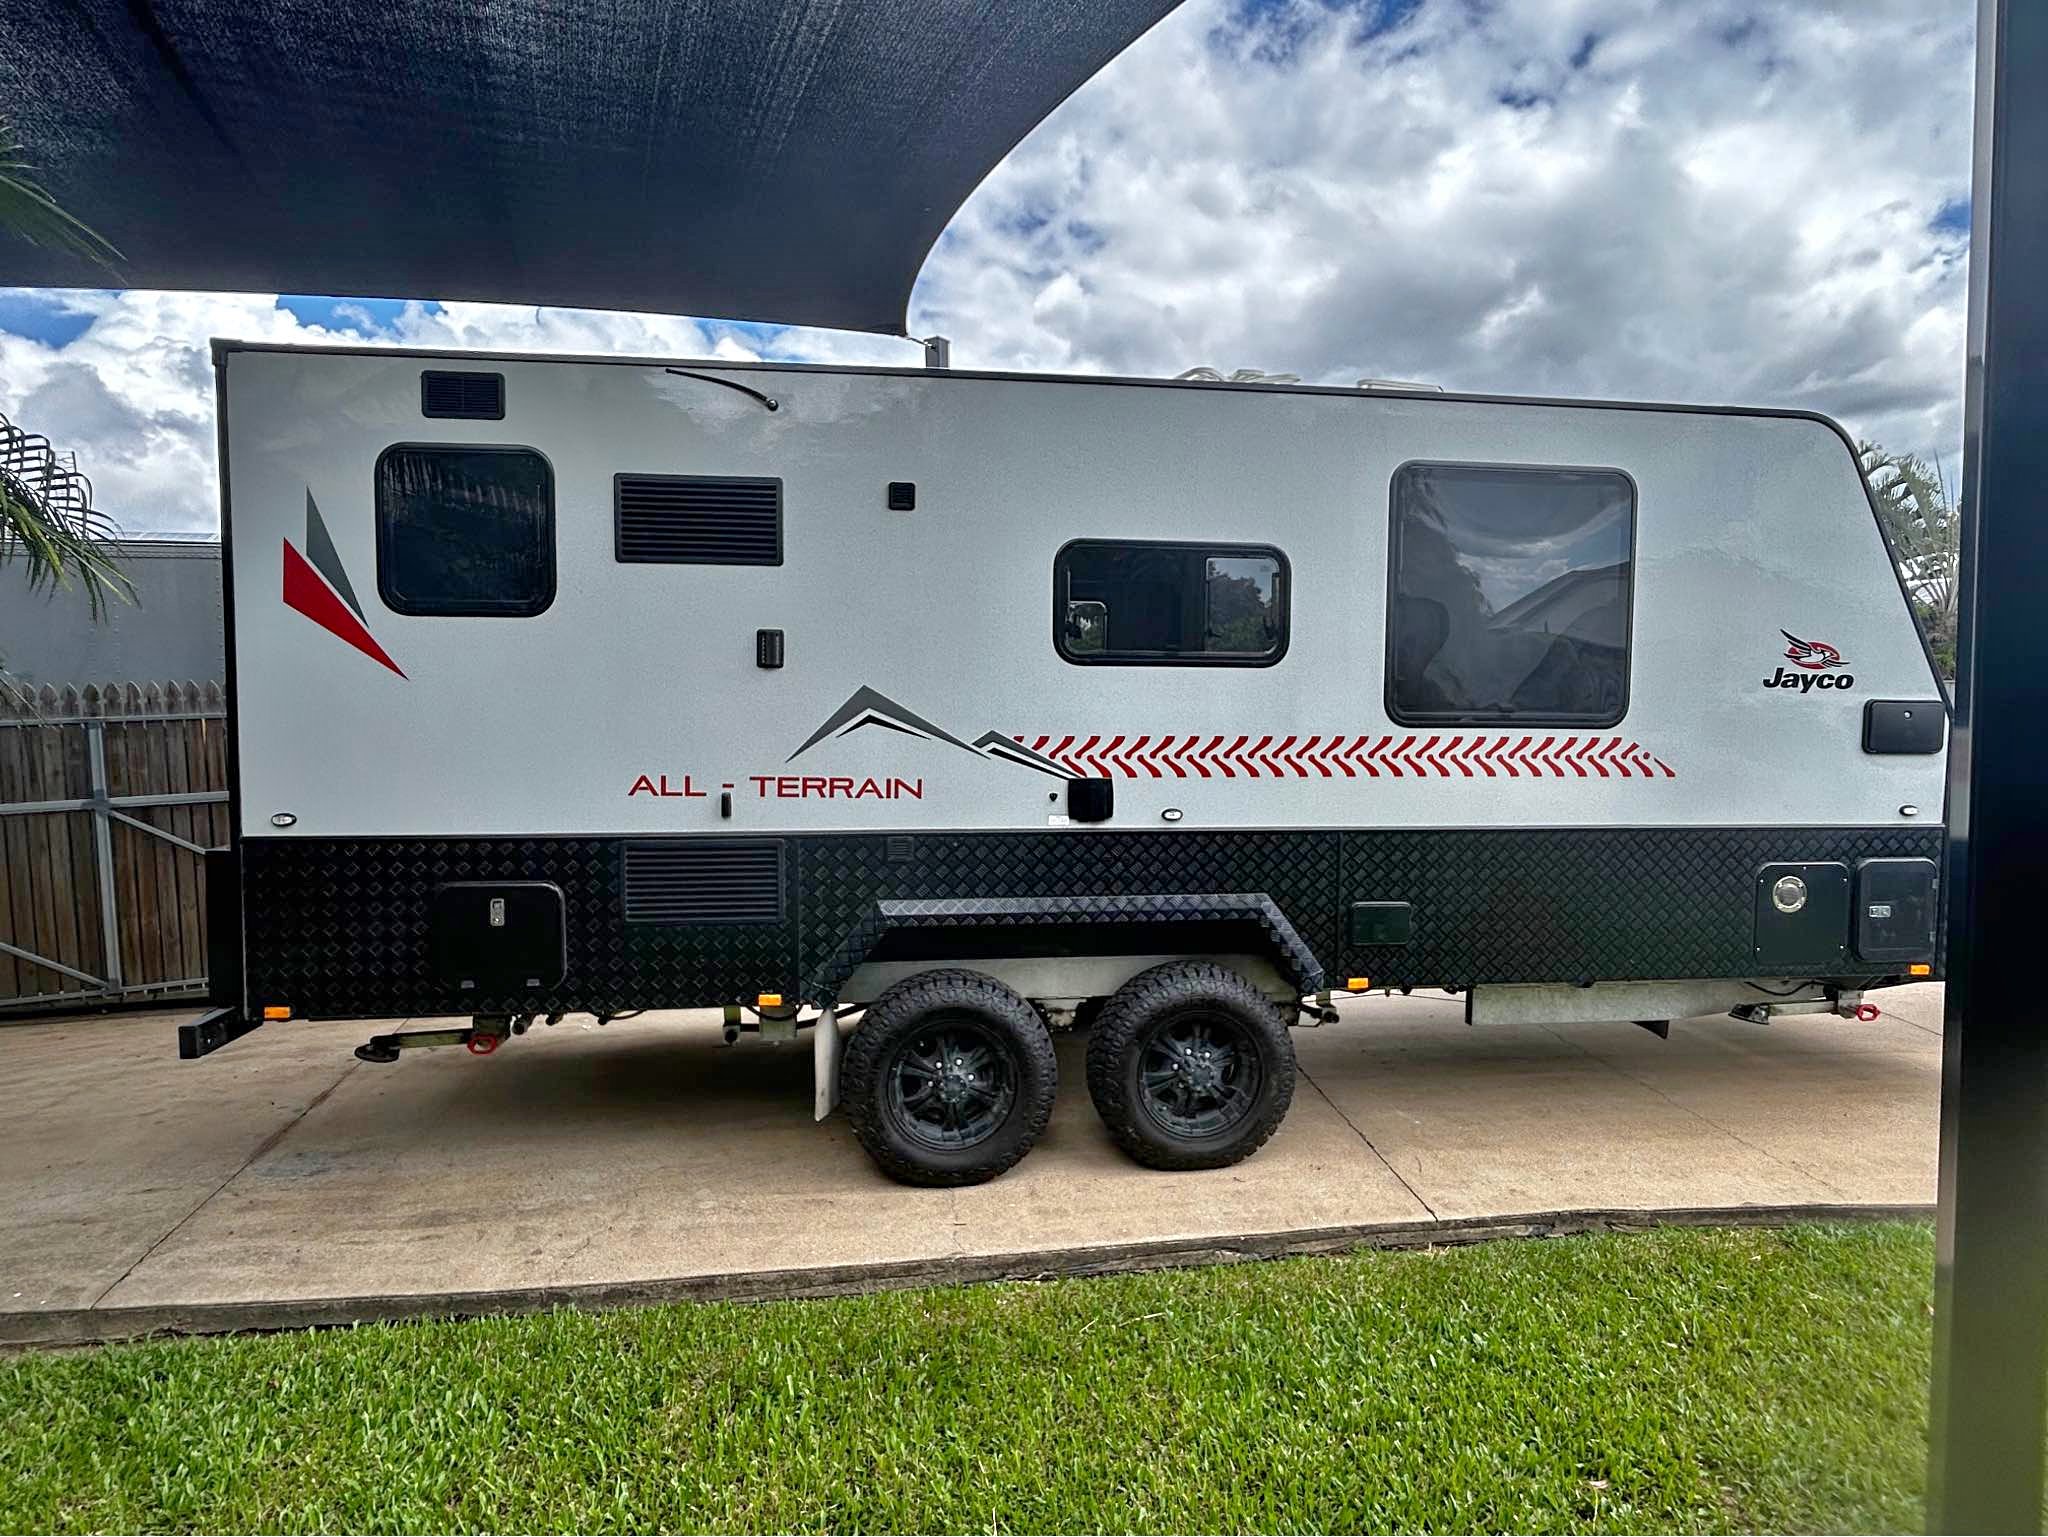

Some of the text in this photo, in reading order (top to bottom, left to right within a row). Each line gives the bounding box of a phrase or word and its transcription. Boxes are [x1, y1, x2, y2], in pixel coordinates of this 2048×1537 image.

[1762, 667, 1854, 693] Jayco
[628, 775, 707, 797] ALL
[749, 776, 922, 799] TERRAIN
